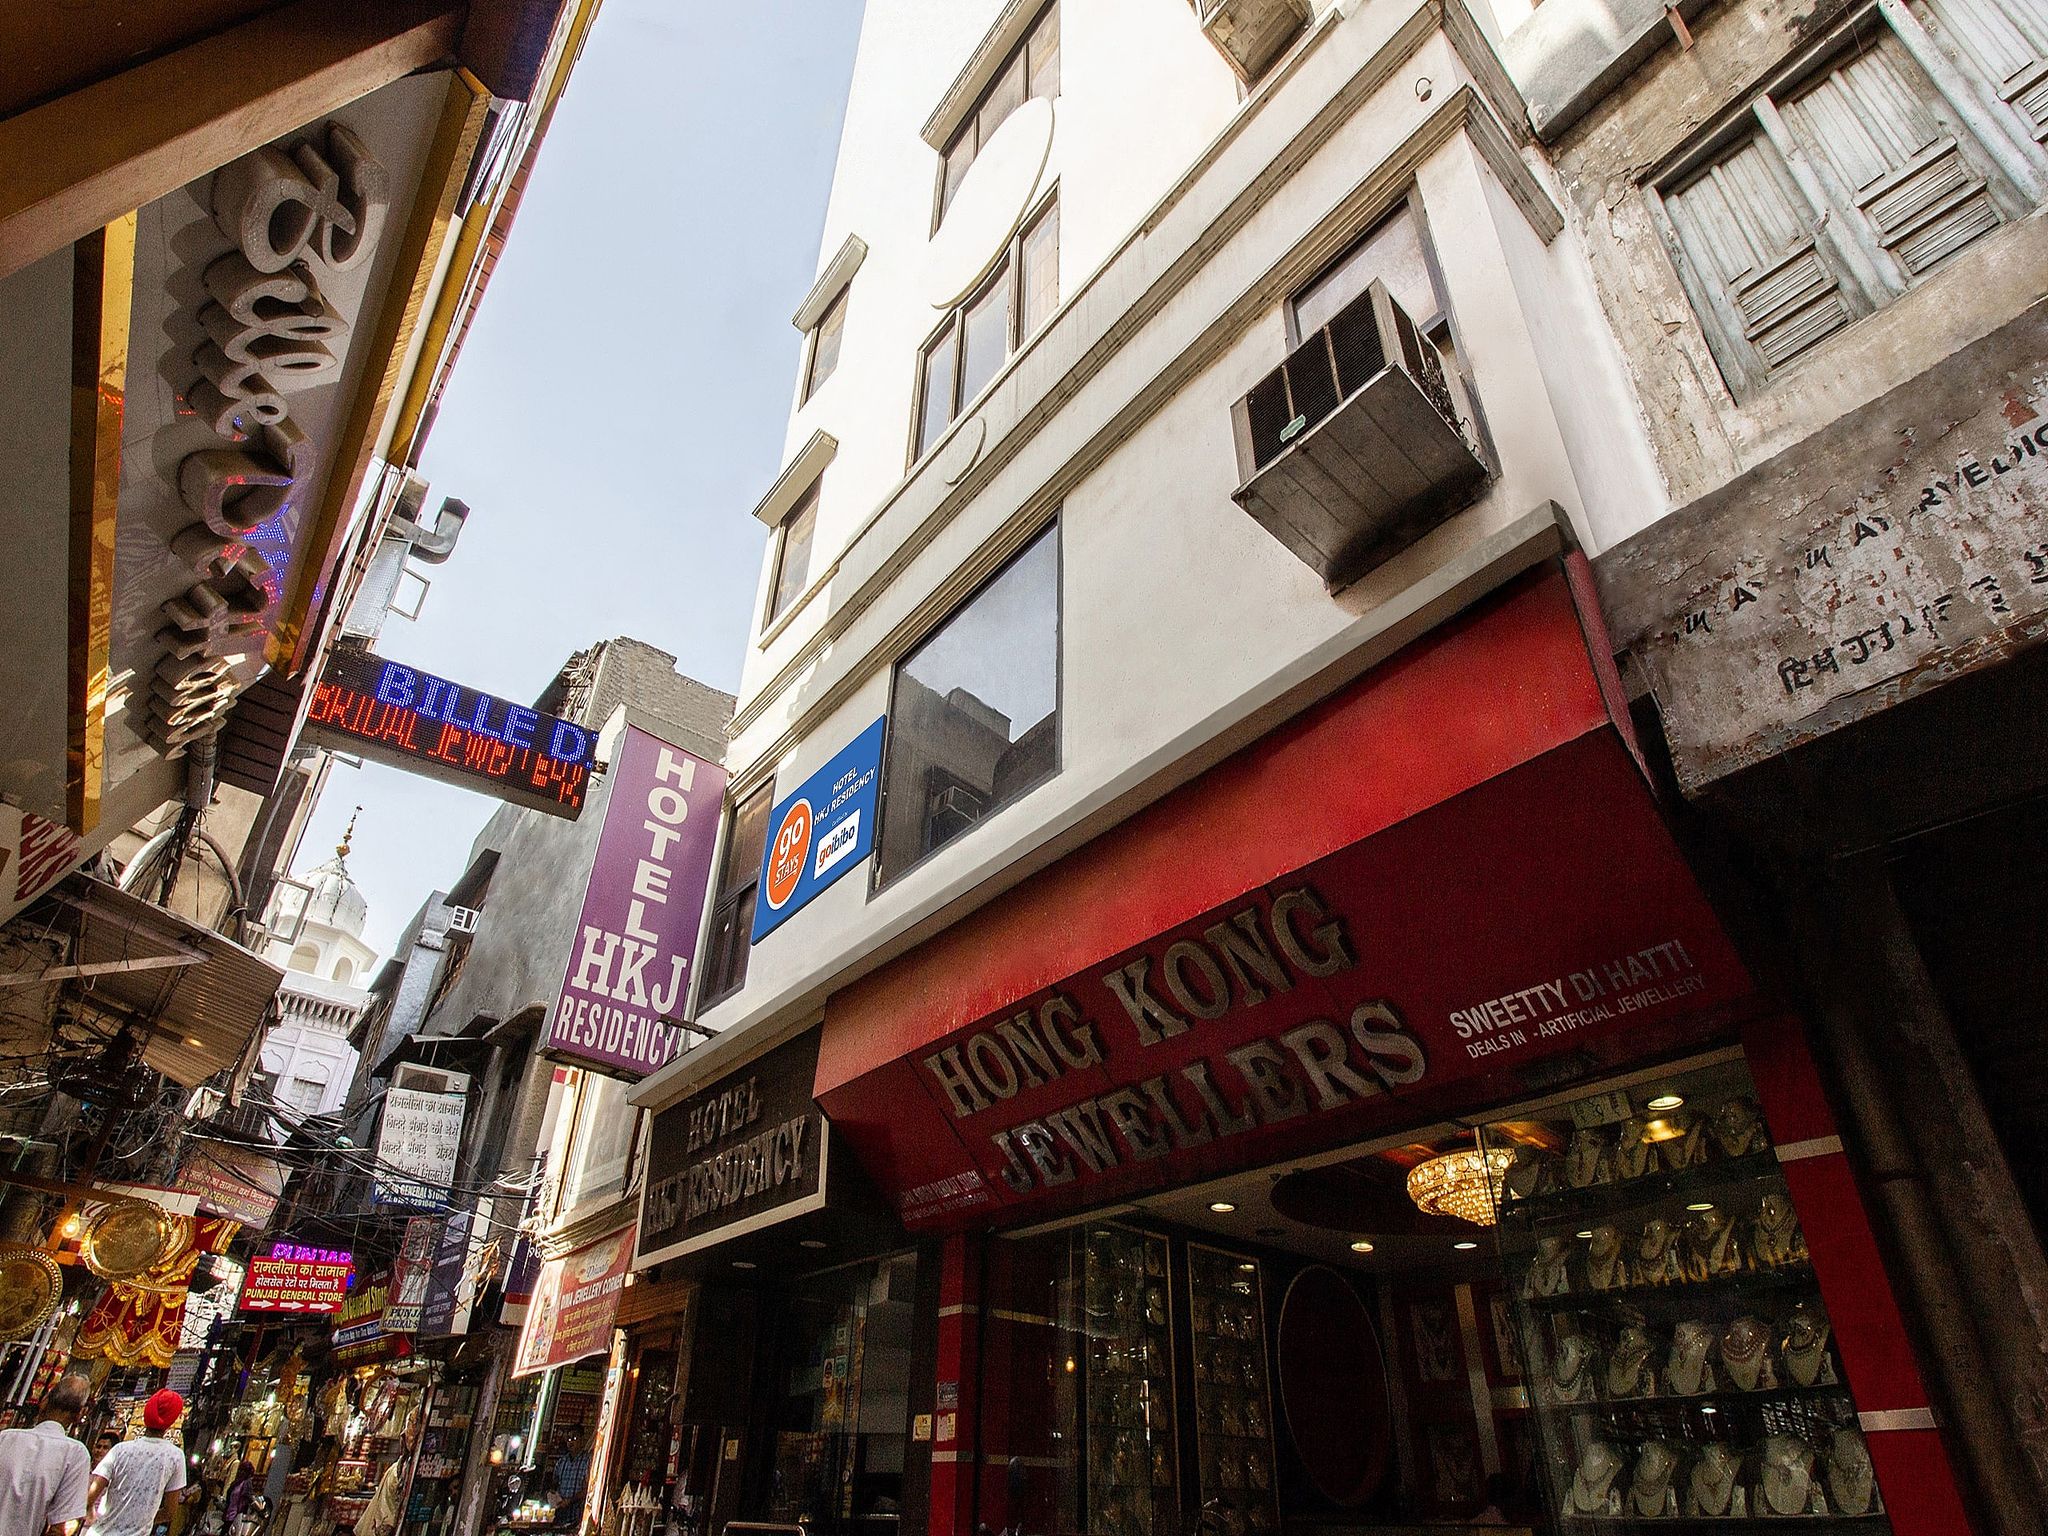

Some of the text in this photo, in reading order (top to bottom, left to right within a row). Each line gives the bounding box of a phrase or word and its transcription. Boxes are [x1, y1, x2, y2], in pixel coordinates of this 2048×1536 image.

[814, 766, 876, 826] HKJ RESIDENCY
[832, 767, 858, 796] HOTEL
[624, 747, 696, 944] HOTEL
[775, 852, 798, 884] STAYS
[778, 816, 805, 867] go
[818, 824, 855, 868] goibibo
[570, 925, 687, 1015] HKJ
[1450, 939, 1694, 1039] SWEETTY DI HATTI
[555, 994, 678, 1066] RESIDENCY
[923, 886, 1358, 1118] HONG KONG
[1466, 1034, 1511, 1059] DEALS
[1511, 1029, 1527, 1046] IN
[1617, 975, 1706, 1014] JEWELLERY
[687, 1075, 759, 1153] HOTEL
[991, 1001, 1428, 1193] JEWELLERS
[400, 1184, 427, 1199] GENERAL
[685, 1114, 806, 1222] RESIDENCY
[211, 1191, 243, 1208] GENERAL
[246, 1205, 270, 1218] STORE
[245, 1289, 343, 1302] PUNJAB GENERAL STORE
[253, 1259, 347, 1277] रामलीला का सामान
[299, 1280, 308, 1288] पर
[309, 1278, 331, 1289] मिलता
[333, 1278, 339, 1290] है
